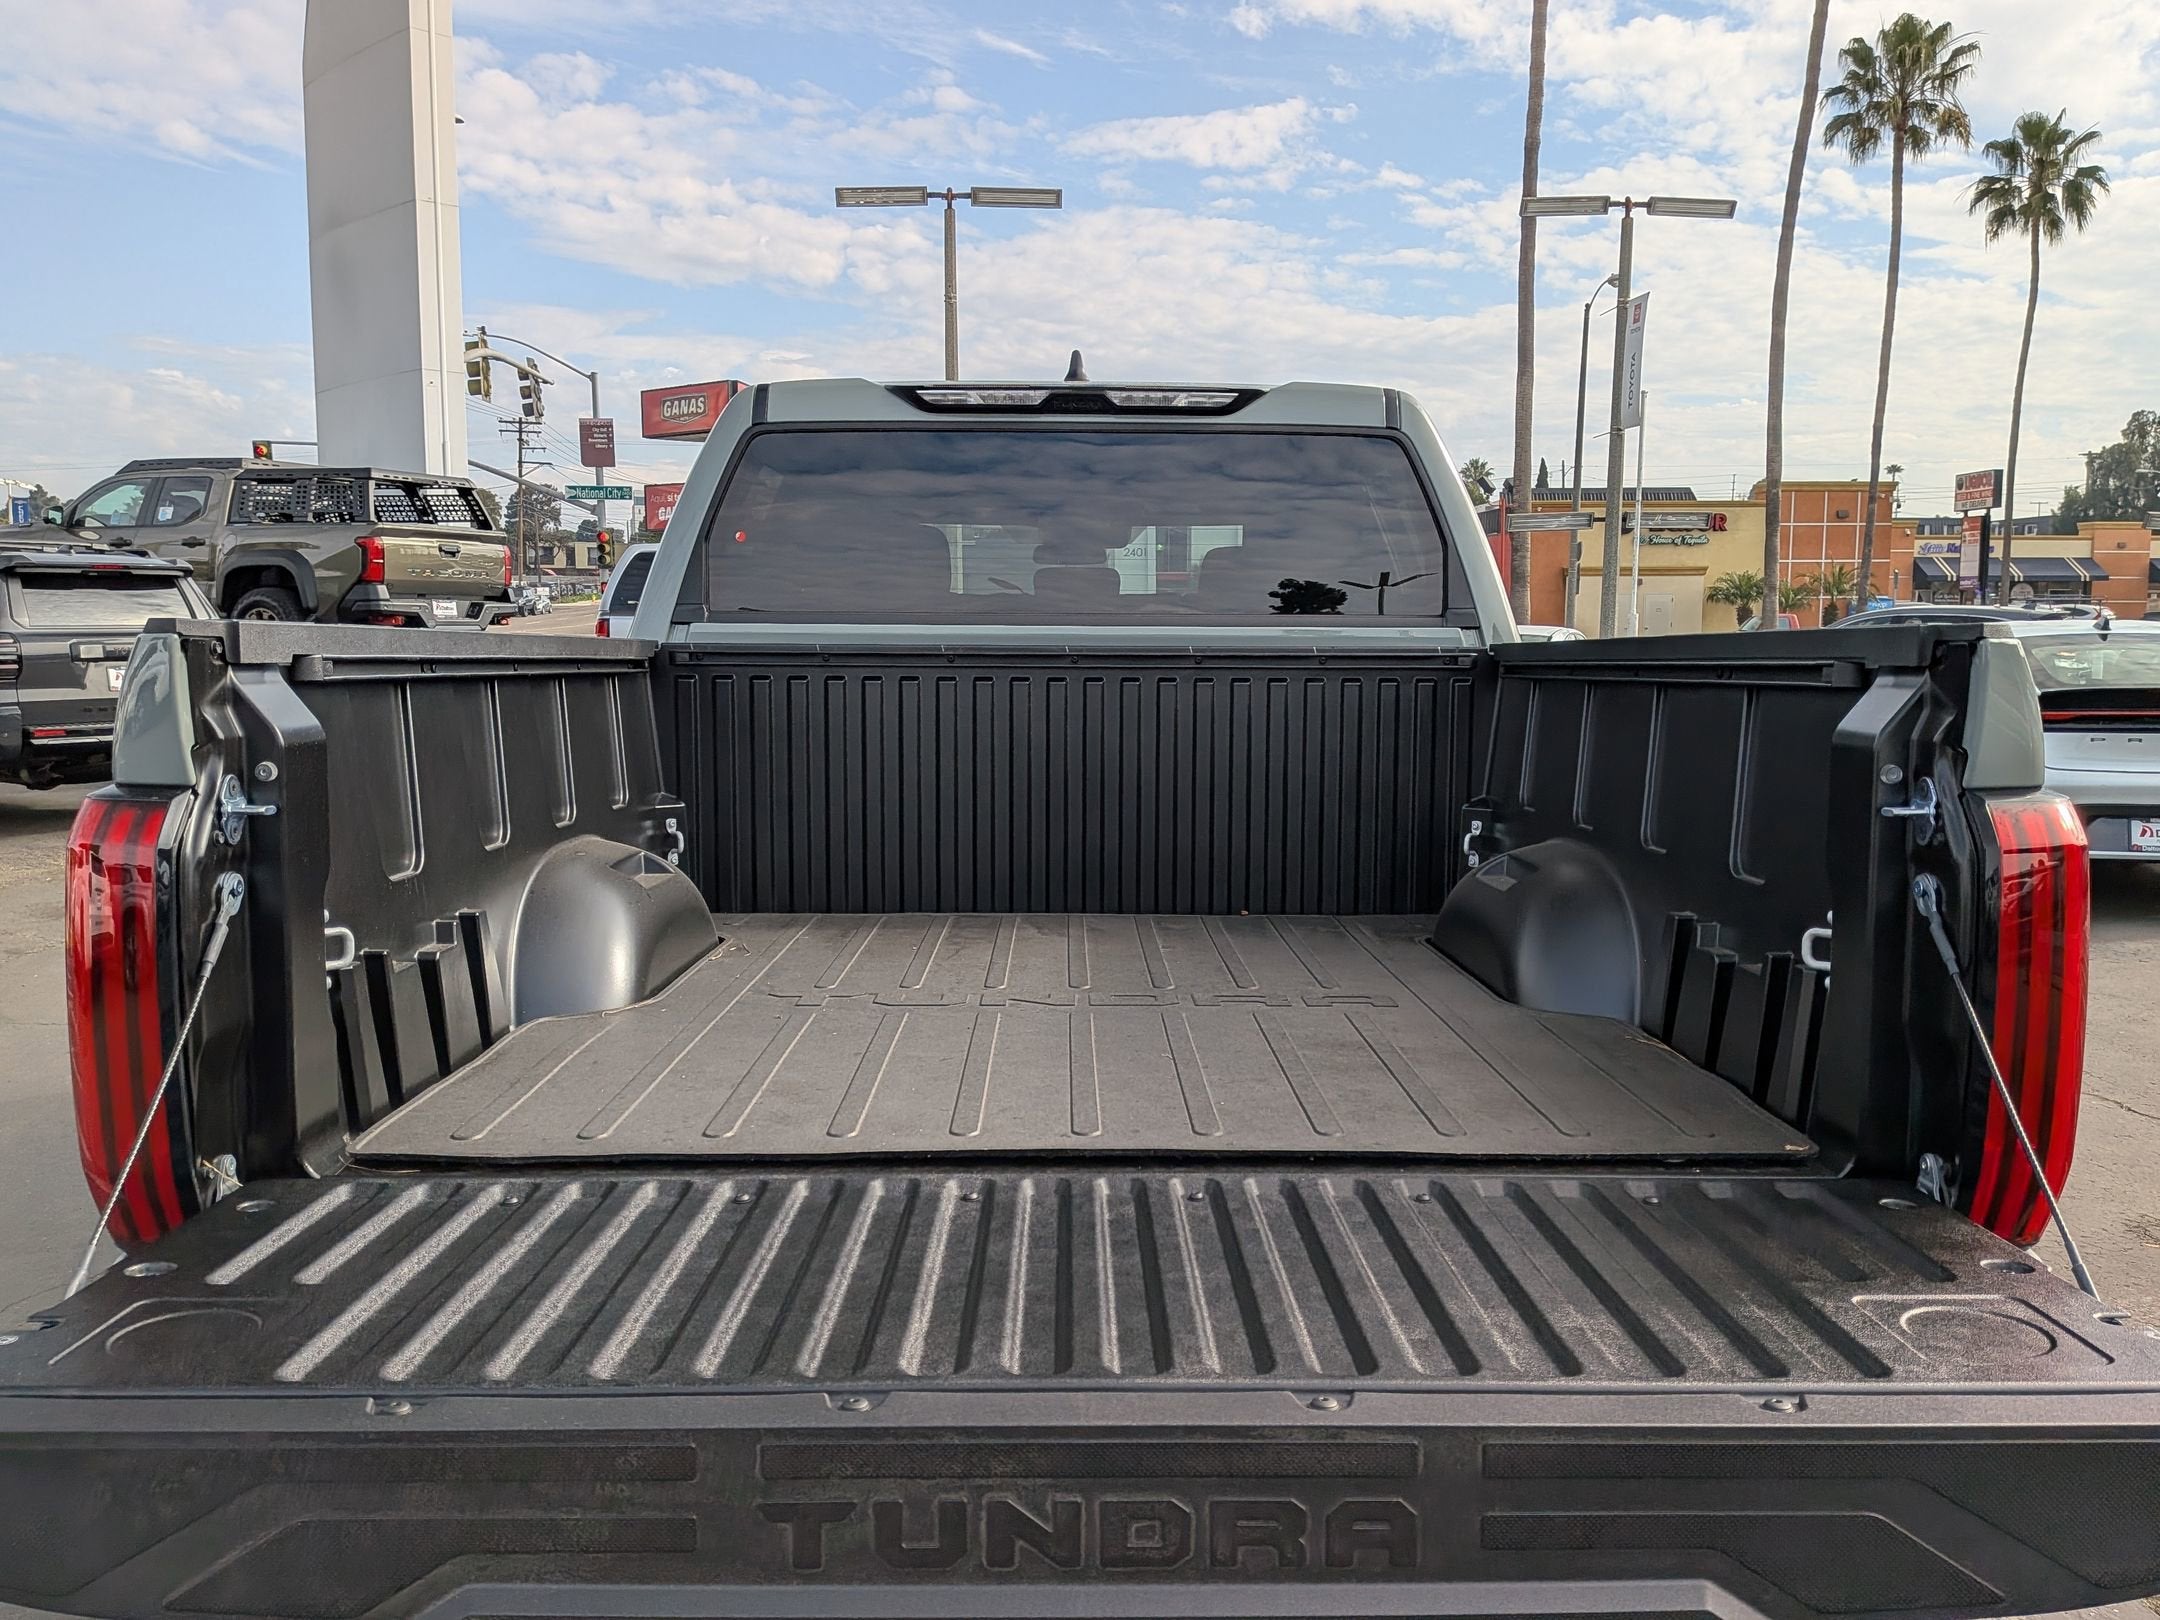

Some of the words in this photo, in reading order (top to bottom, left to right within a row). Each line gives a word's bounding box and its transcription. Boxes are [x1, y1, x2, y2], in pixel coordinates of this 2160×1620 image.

[1627, 351, 1637, 409] TOYOTA
[663, 397, 705, 417] GANAS
[576, 487, 606, 499] National
[608, 487, 622, 500] City
[1650, 534, 1673, 544] House
[1674, 534, 1682, 546] of
[1683, 534, 1709, 546] Tequila
[1123, 547, 1147, 558] 2401
[407, 567, 490, 579] TACOMA
[768, 992, 1398, 1008] TUNDRA
[757, 1496, 1419, 1572] TUNDRA
